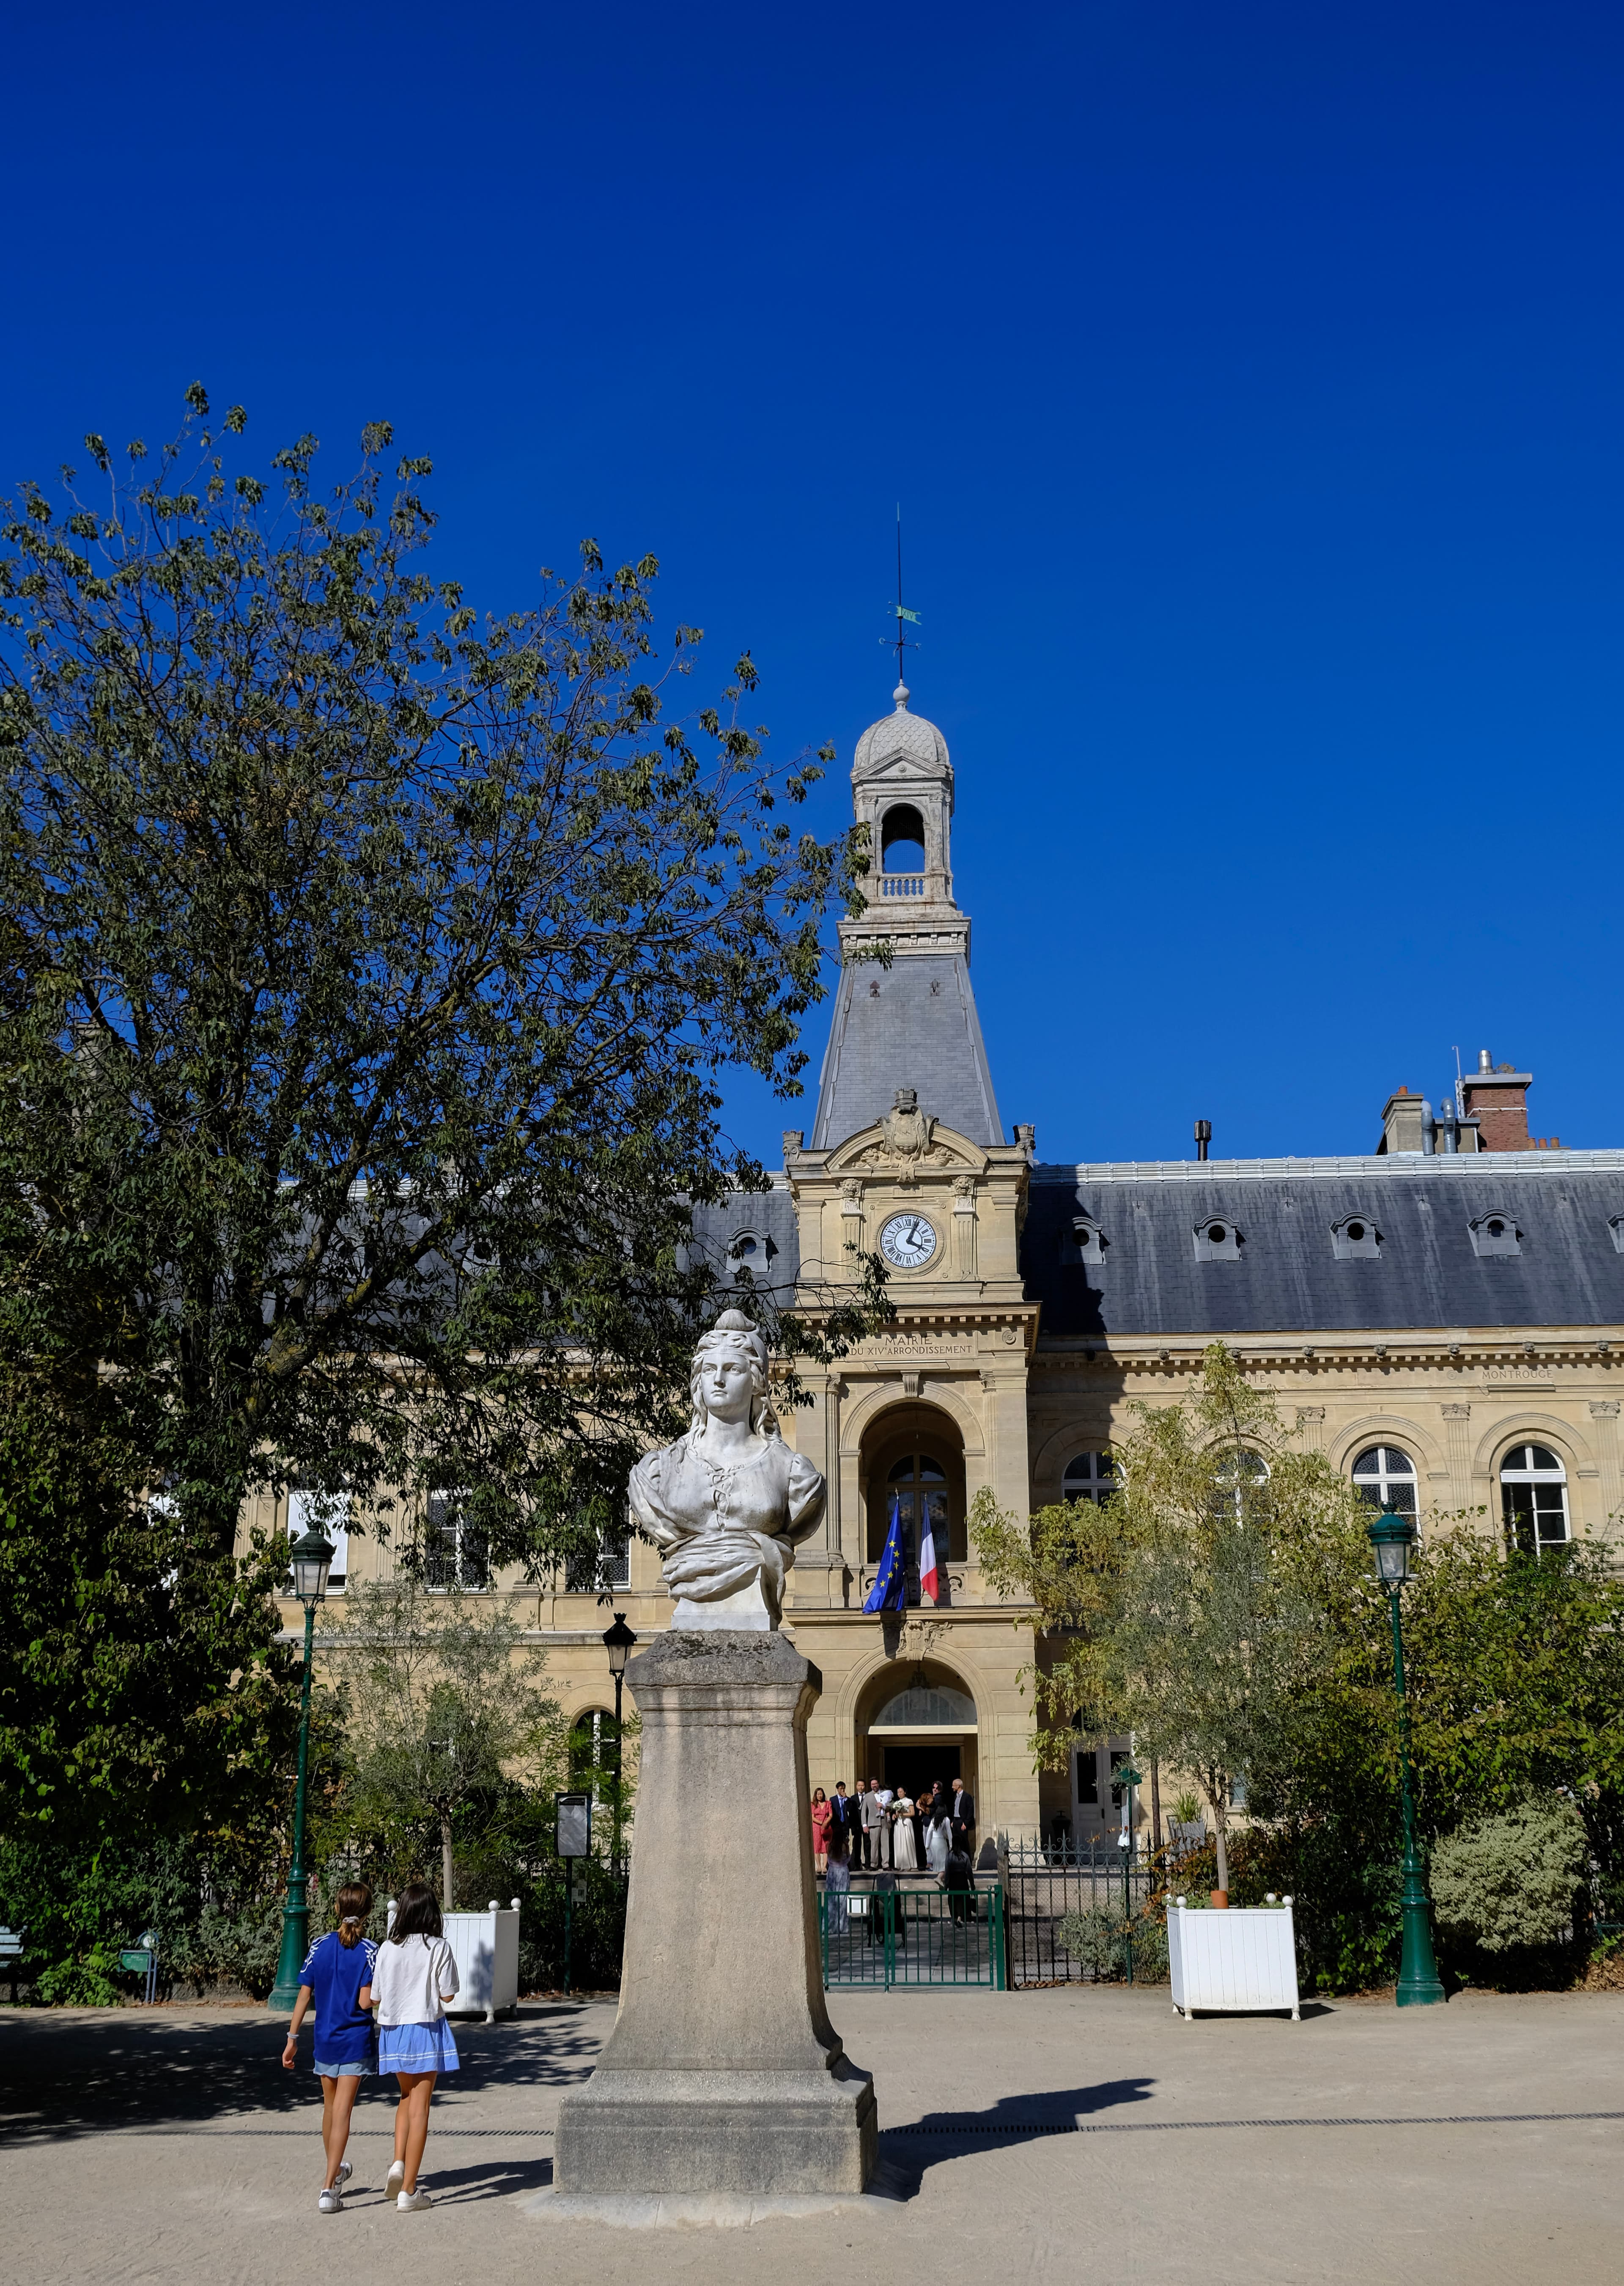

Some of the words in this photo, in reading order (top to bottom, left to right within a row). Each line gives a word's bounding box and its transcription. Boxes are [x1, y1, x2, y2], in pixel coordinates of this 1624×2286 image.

[903, 609, 914, 619] XIV
[894, 1221, 903, 1230] XI
[887, 1246, 896, 1256] VIII
[894, 1253, 903, 1262] VII
[906, 1256, 911, 1264] VI
[885, 1335, 933, 1346] MAIRIE
[887, 1345, 972, 1355] ARRONDISSEMENT
[1482, 1370, 1553, 1379] MONTROUGE
